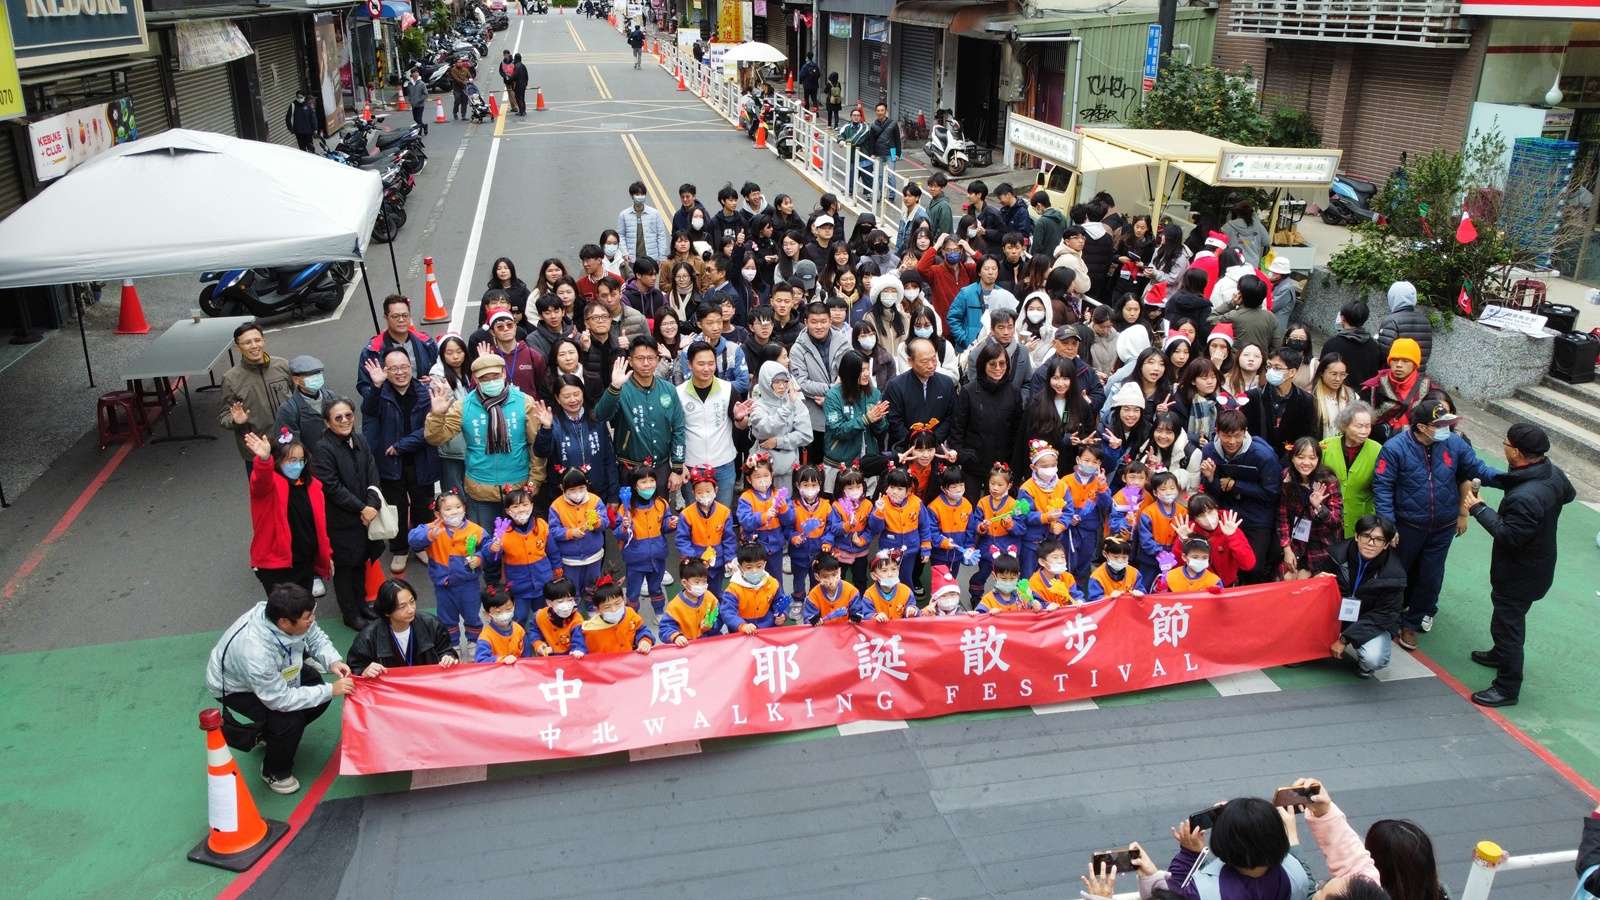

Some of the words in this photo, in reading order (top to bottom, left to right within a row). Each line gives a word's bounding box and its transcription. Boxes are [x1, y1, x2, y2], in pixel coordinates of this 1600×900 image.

[45, 144, 62, 157] CLUB
[538, 602, 1193, 717] 中原耶誕散步節
[538, 720, 618, 750] 中北
[643, 691, 893, 737] WALKING
[945, 653, 1199, 704] FESTIVAL
